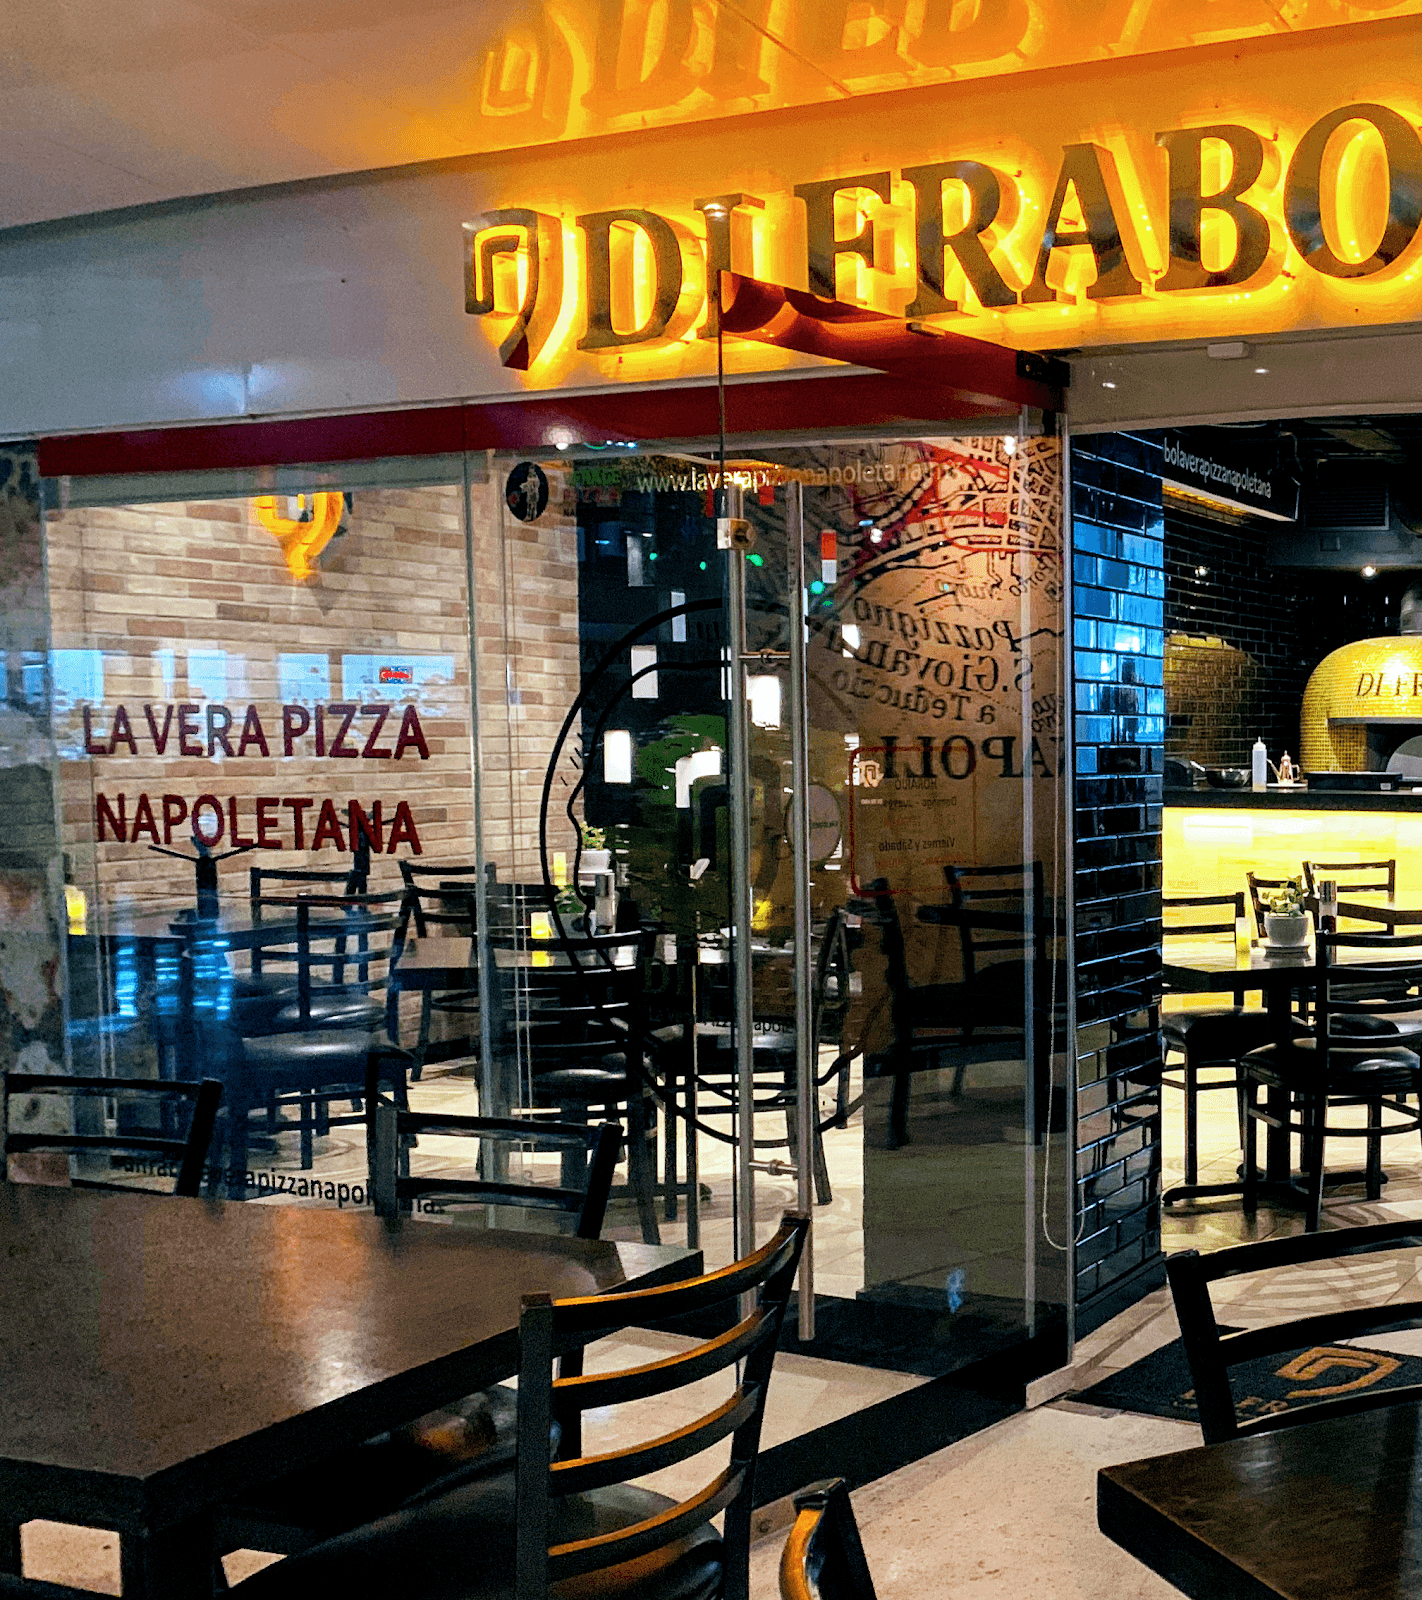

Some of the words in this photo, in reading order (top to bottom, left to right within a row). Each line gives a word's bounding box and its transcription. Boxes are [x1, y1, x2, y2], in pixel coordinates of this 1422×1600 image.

[577, 193, 764, 351] DI
[1356, 672, 1384, 697] DI
[83, 704, 137, 755] LA
[144, 704, 270, 758] VERA
[283, 704, 430, 760] PIZZA
[96, 793, 423, 855] NAPOLETANA
